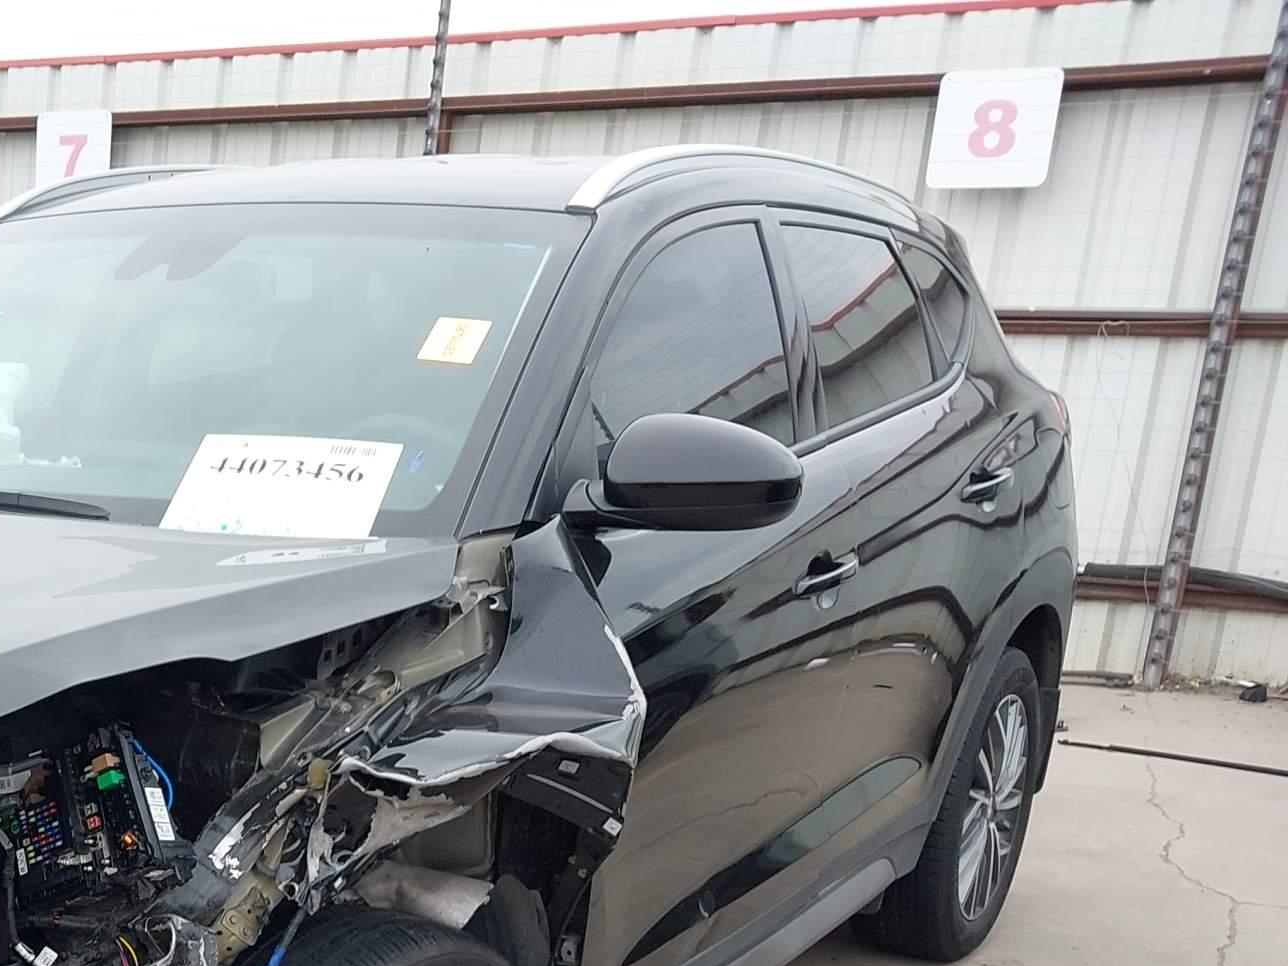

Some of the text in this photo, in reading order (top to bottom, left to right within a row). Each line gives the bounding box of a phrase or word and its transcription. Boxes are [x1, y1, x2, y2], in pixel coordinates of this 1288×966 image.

[967, 98, 1018, 158] 8
[58, 133, 89, 177] 7
[210, 456, 364, 483] 44073456
